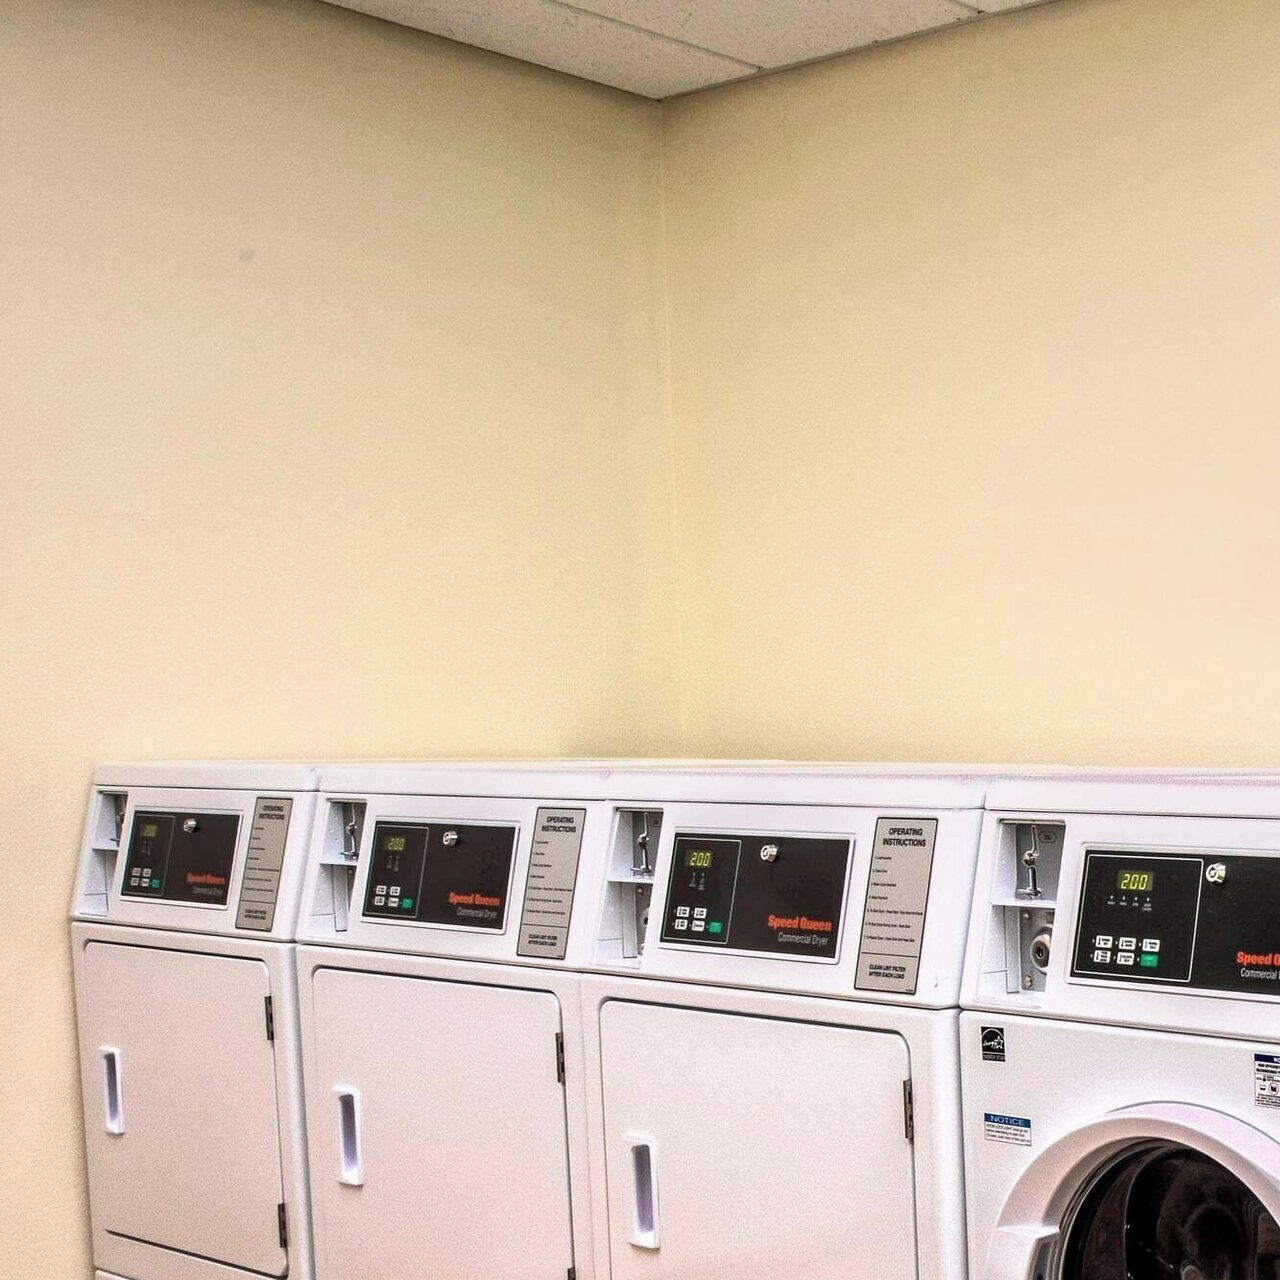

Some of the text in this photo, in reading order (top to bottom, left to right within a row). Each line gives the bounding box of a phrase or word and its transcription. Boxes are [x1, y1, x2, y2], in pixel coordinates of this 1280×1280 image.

[889, 828, 922, 836] OPERATING
[883, 839, 926, 847] INSTRUCTIONS
[1121, 874, 1147, 889] 200
[768, 915, 831, 931] Speed Queen
[1237, 952, 1272, 965] Speed
[1241, 968, 1277, 979] Commercial
[991, 1116, 1025, 1126] NOTICE
